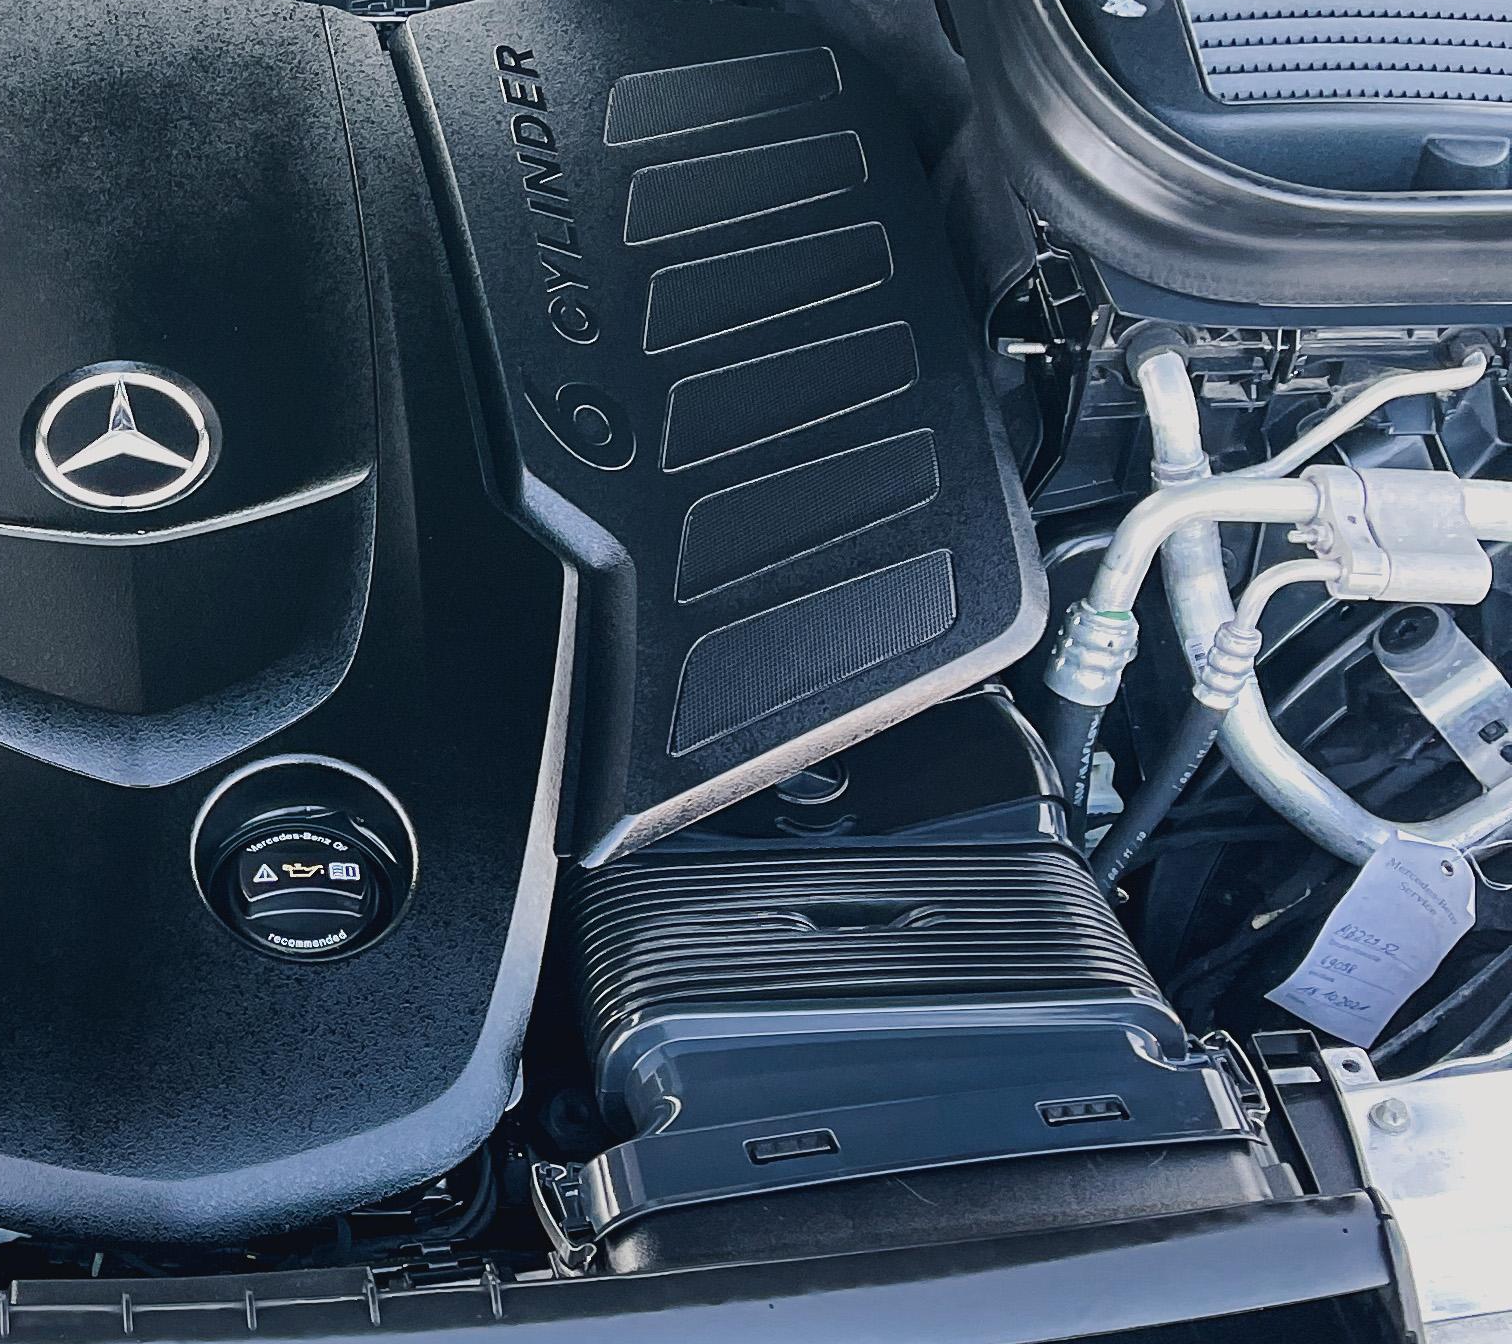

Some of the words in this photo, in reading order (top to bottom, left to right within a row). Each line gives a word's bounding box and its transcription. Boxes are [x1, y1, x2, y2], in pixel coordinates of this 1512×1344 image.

[494, 43, 601, 346] CYLINDER
[523, 378, 637, 472] 6
[246, 832, 332, 853] Mercedes-Benz
[1388, 856, 1457, 926] Mercedes-Benz
[1398, 880, 1438, 916] Service
[267, 929, 348, 949] recommended
